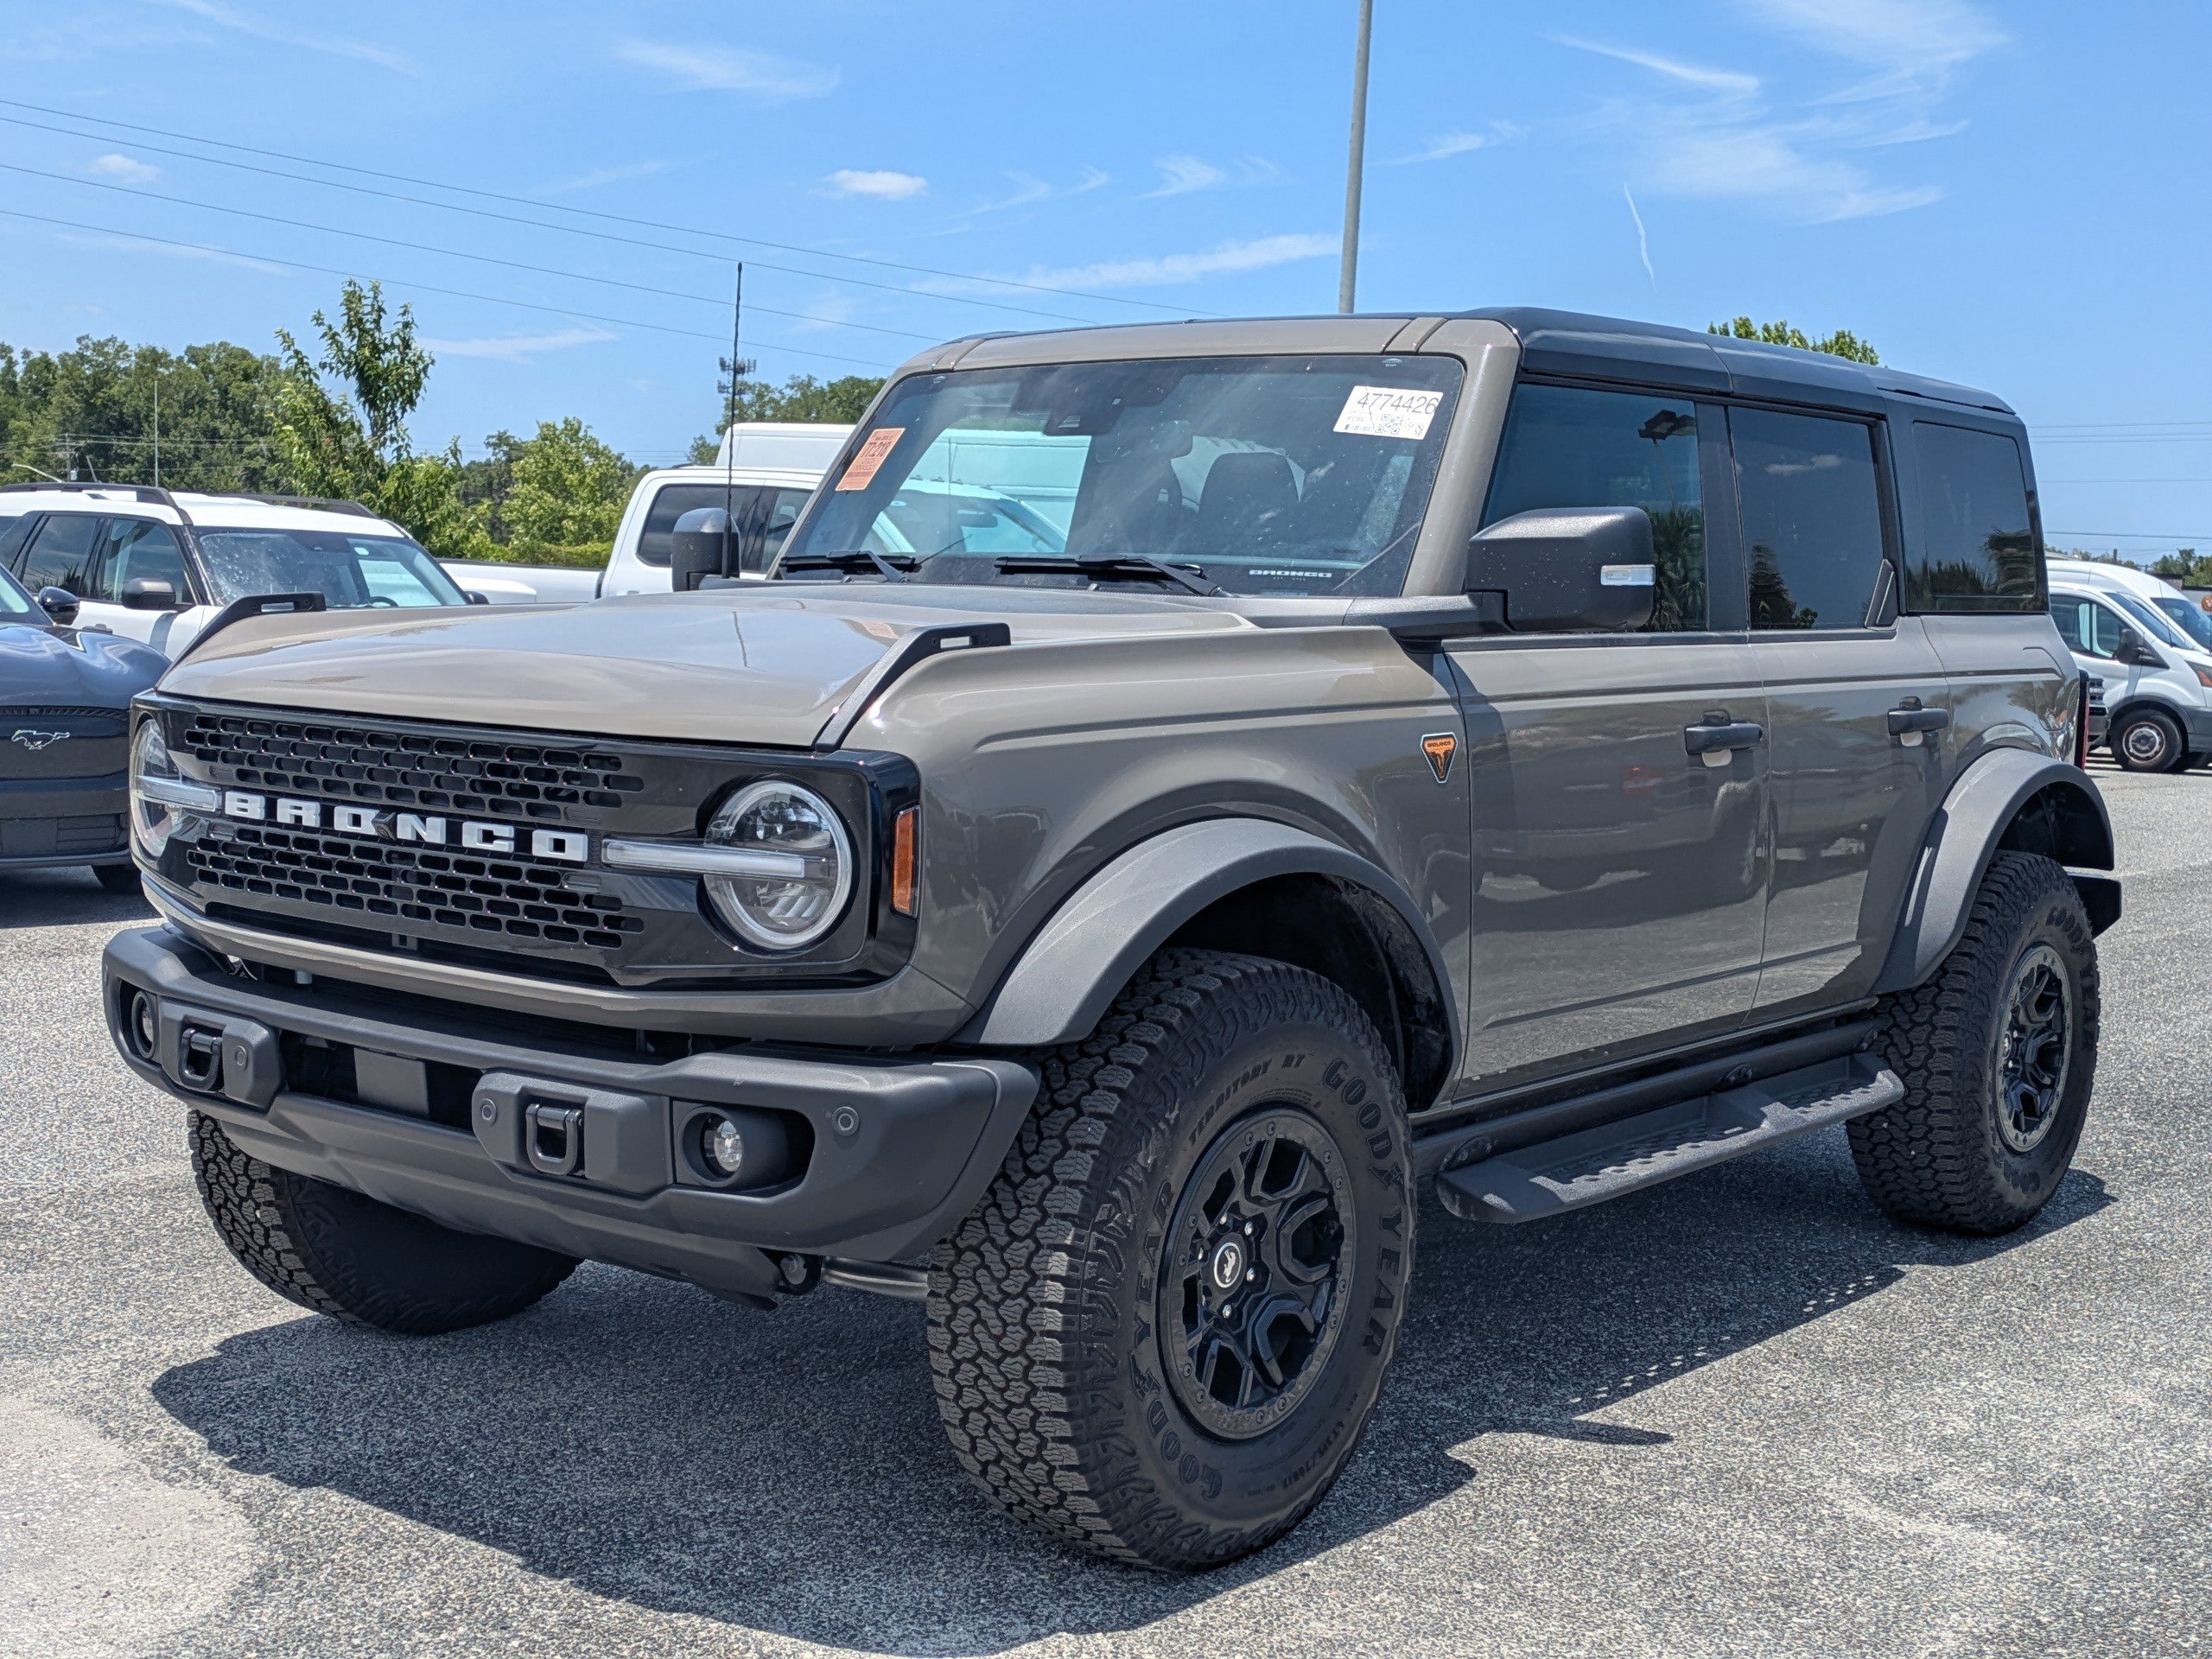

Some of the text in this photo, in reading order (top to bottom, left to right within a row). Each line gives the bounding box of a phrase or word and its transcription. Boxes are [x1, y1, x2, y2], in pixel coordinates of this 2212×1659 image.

[1357, 392, 1440, 415] 4774426
[1249, 569, 1332, 578] BRONCO
[225, 791, 588, 862] BRONCO
[1188, 1058, 1273, 1146] TERRITORY
[1323, 1057, 1410, 1357] GOODYEAR
[1128, 1179, 1224, 1501] GOODYEAR
